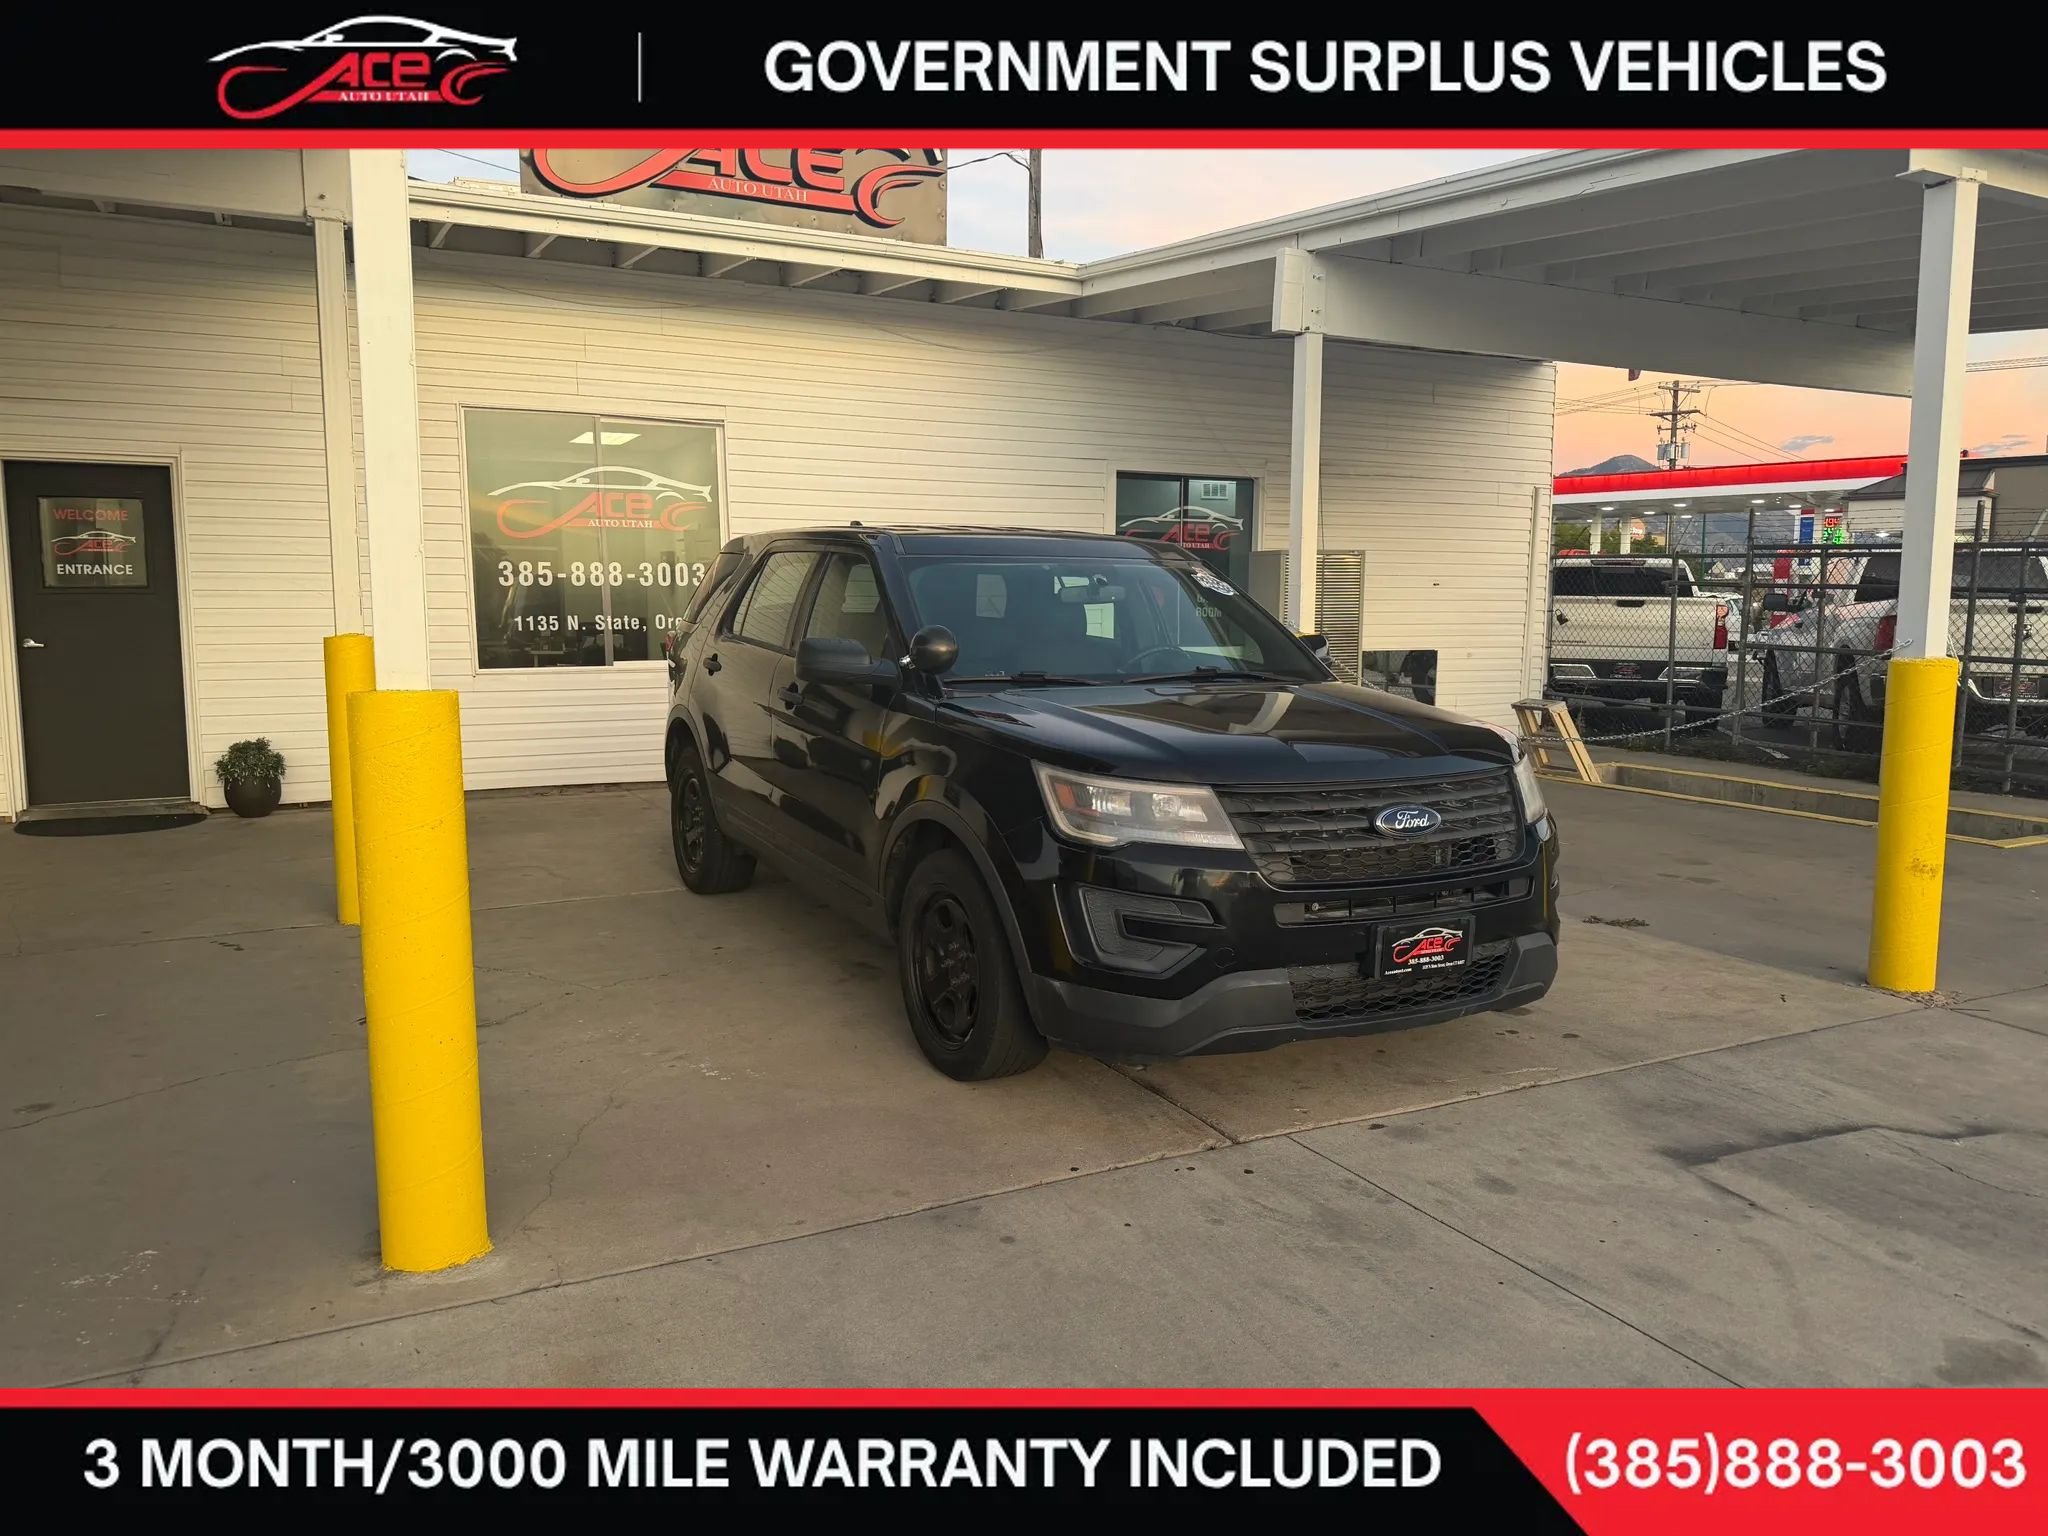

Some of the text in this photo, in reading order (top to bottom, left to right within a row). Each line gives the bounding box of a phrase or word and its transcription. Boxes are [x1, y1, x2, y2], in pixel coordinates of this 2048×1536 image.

[707, 177, 808, 202] AUTO UTAH
[53, 508, 129, 521] WELCOME
[588, 519, 653, 529] AUTO UTAH
[1192, 542, 1210, 550] UTAH
[56, 563, 133, 575] ENTRANCE
[498, 560, 705, 588] 385-888-3003
[514, 615, 559, 632] 1135
[567, 615, 586, 631] N.
[595, 614, 647, 632] State,
[1395, 810, 1430, 829] Ford
